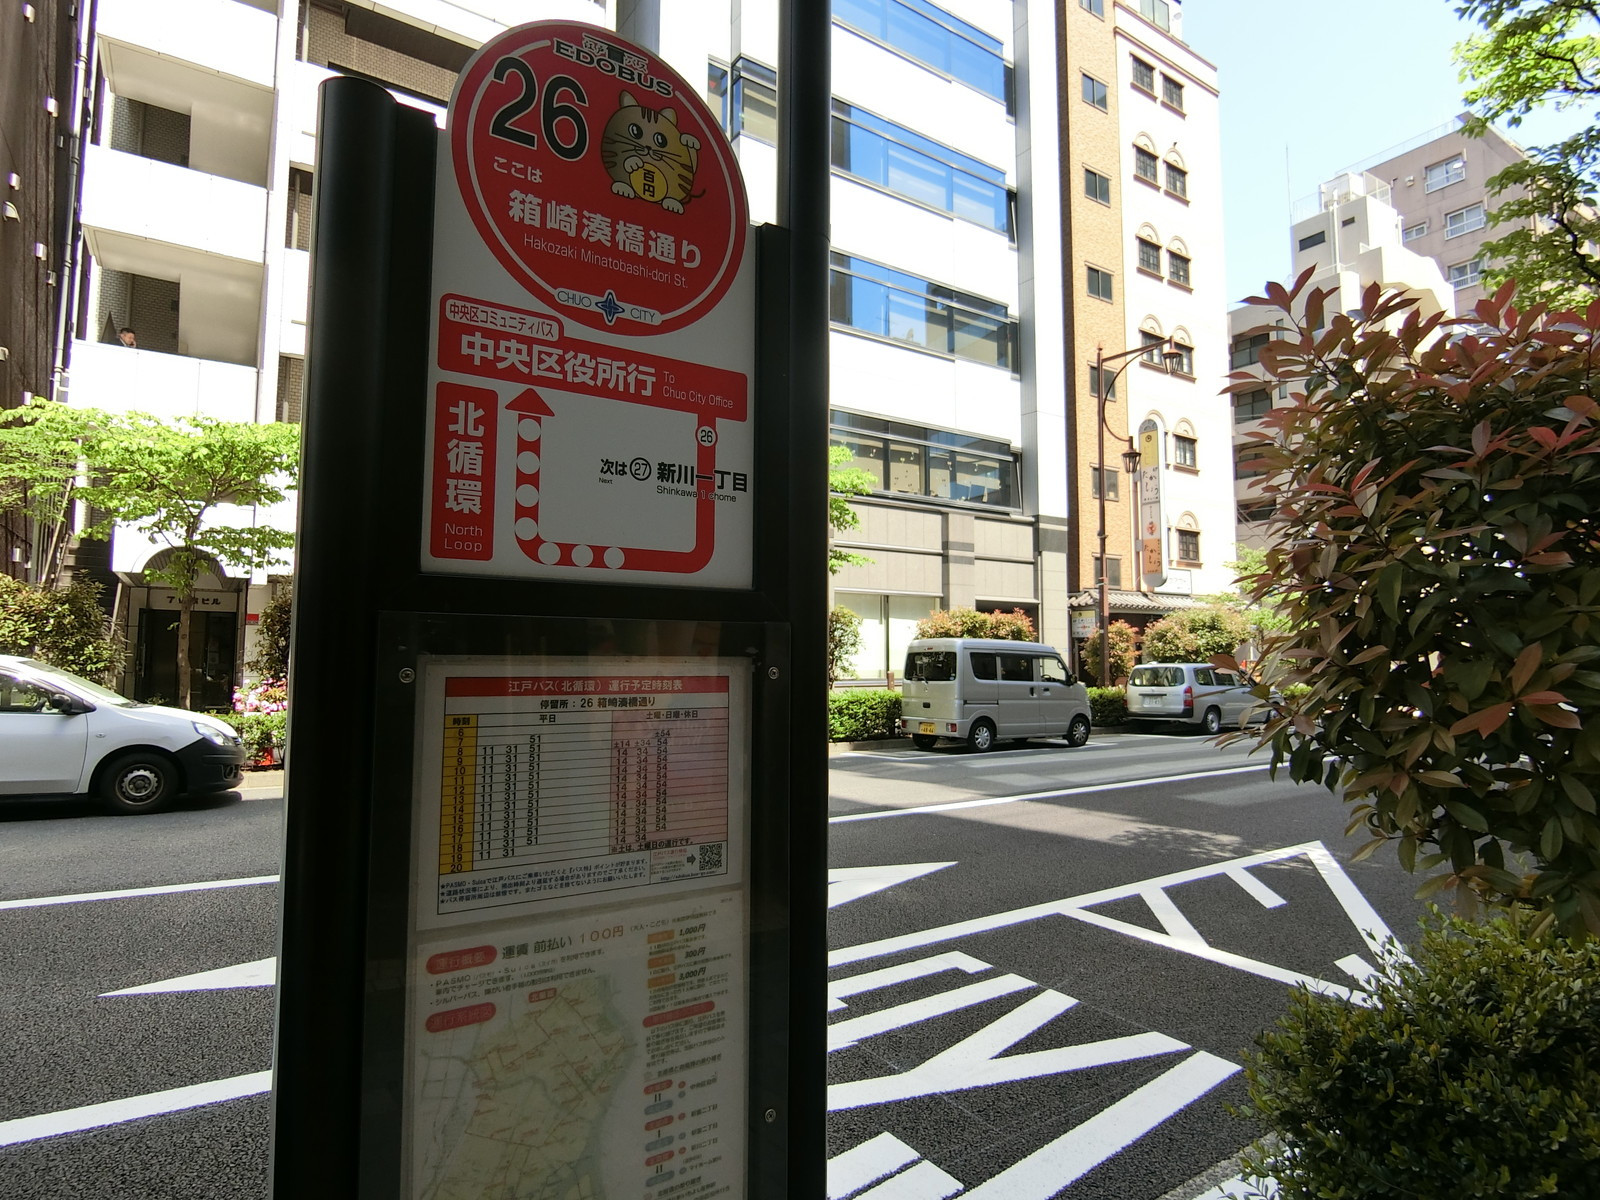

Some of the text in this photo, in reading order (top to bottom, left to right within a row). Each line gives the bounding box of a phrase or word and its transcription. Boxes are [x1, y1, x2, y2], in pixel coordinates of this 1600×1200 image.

[554, 39, 673, 97] EDOBUS
[490, 56, 589, 161] 26
[493, 156, 543, 183] ここは
[642, 168, 655, 198] 百円
[508, 189, 701, 269] 箱崎湊橋通り
[524, 233, 688, 288] Hakozaki Minatobashi-dori St.
[557, 290, 655, 323] CHUO CITY
[449, 301, 554, 338] 中央区コミュニティバス
[461, 332, 656, 397] 中央区役所行
[664, 371, 675, 384] To
[663, 386, 734, 409] Chuo City Office
[700, 429, 713, 443] 26
[446, 400, 485, 515] 北循環
[599, 477, 613, 485] Next
[600, 458, 628, 477] 次は
[656, 461, 748, 493] 新川一丁目
[656, 486, 698, 498] Shinkawa
[708, 492, 737, 502] chome
[444, 522, 484, 537] North
[444, 538, 483, 553] Loop
[608, 679, 683, 691] 運行予定時刻表
[597, 696, 656, 708] 箱崎湊橋通り
[539, 714, 556, 723] 平日
[458, 728, 464, 737] 6
[458, 738, 463, 746] 7
[530, 735, 541, 743] 51
[457, 747, 463, 756] 8
[483, 747, 494, 755] 11
[506, 745, 518, 754] 31
[457, 757, 462, 765] 9
[482, 756, 494, 764] 11
[505, 755, 517, 763] 31
[529, 754, 540, 762] 51
[454, 767, 466, 775] 10
[482, 766, 493, 774] 11
[505, 764, 517, 772] 31
[529, 763, 540, 771] 51
[454, 776, 464, 785] 11
[482, 775, 493, 783] 11
[505, 773, 517, 782] 31
[528, 772, 540, 780] 51
[637, 765, 648, 773] 34
[453, 796, 464, 804] 13
[481, 794, 492, 803] 11
[504, 792, 516, 801] 31
[528, 791, 539, 799] 51
[636, 782, 647, 790] 34
[454, 786, 464, 795] 12
[482, 785, 493, 793] 11
[505, 783, 516, 791] 31
[453, 806, 464, 814] 14
[481, 804, 492, 812] 11
[504, 802, 516, 810] 31
[528, 800, 539, 808] 51
[636, 791, 647, 799] 34
[453, 815, 464, 824] 15
[481, 813, 492, 822] 11
[504, 811, 516, 820] 31
[527, 809, 539, 817] 51
[656, 798, 667, 806] 54
[452, 825, 463, 834] 16
[480, 823, 492, 831] 11
[504, 820, 515, 829] 31
[636, 808, 647, 816] 34
[656, 806, 666, 814] 54
[452, 815, 666, 843] 17 11 31 51 14 34 54
[451, 854, 463, 863] 19
[479, 851, 491, 860] 11
[503, 849, 514, 857] 31
[636, 834, 646, 842] 34
[452, 844, 463, 853] 18
[480, 842, 491, 850] 11
[503, 839, 515, 848] 31
[527, 837, 538, 845] 51
[656, 823, 666, 831] 54
[450, 864, 462, 873] 20
[534, 936, 572, 954] 前払い
